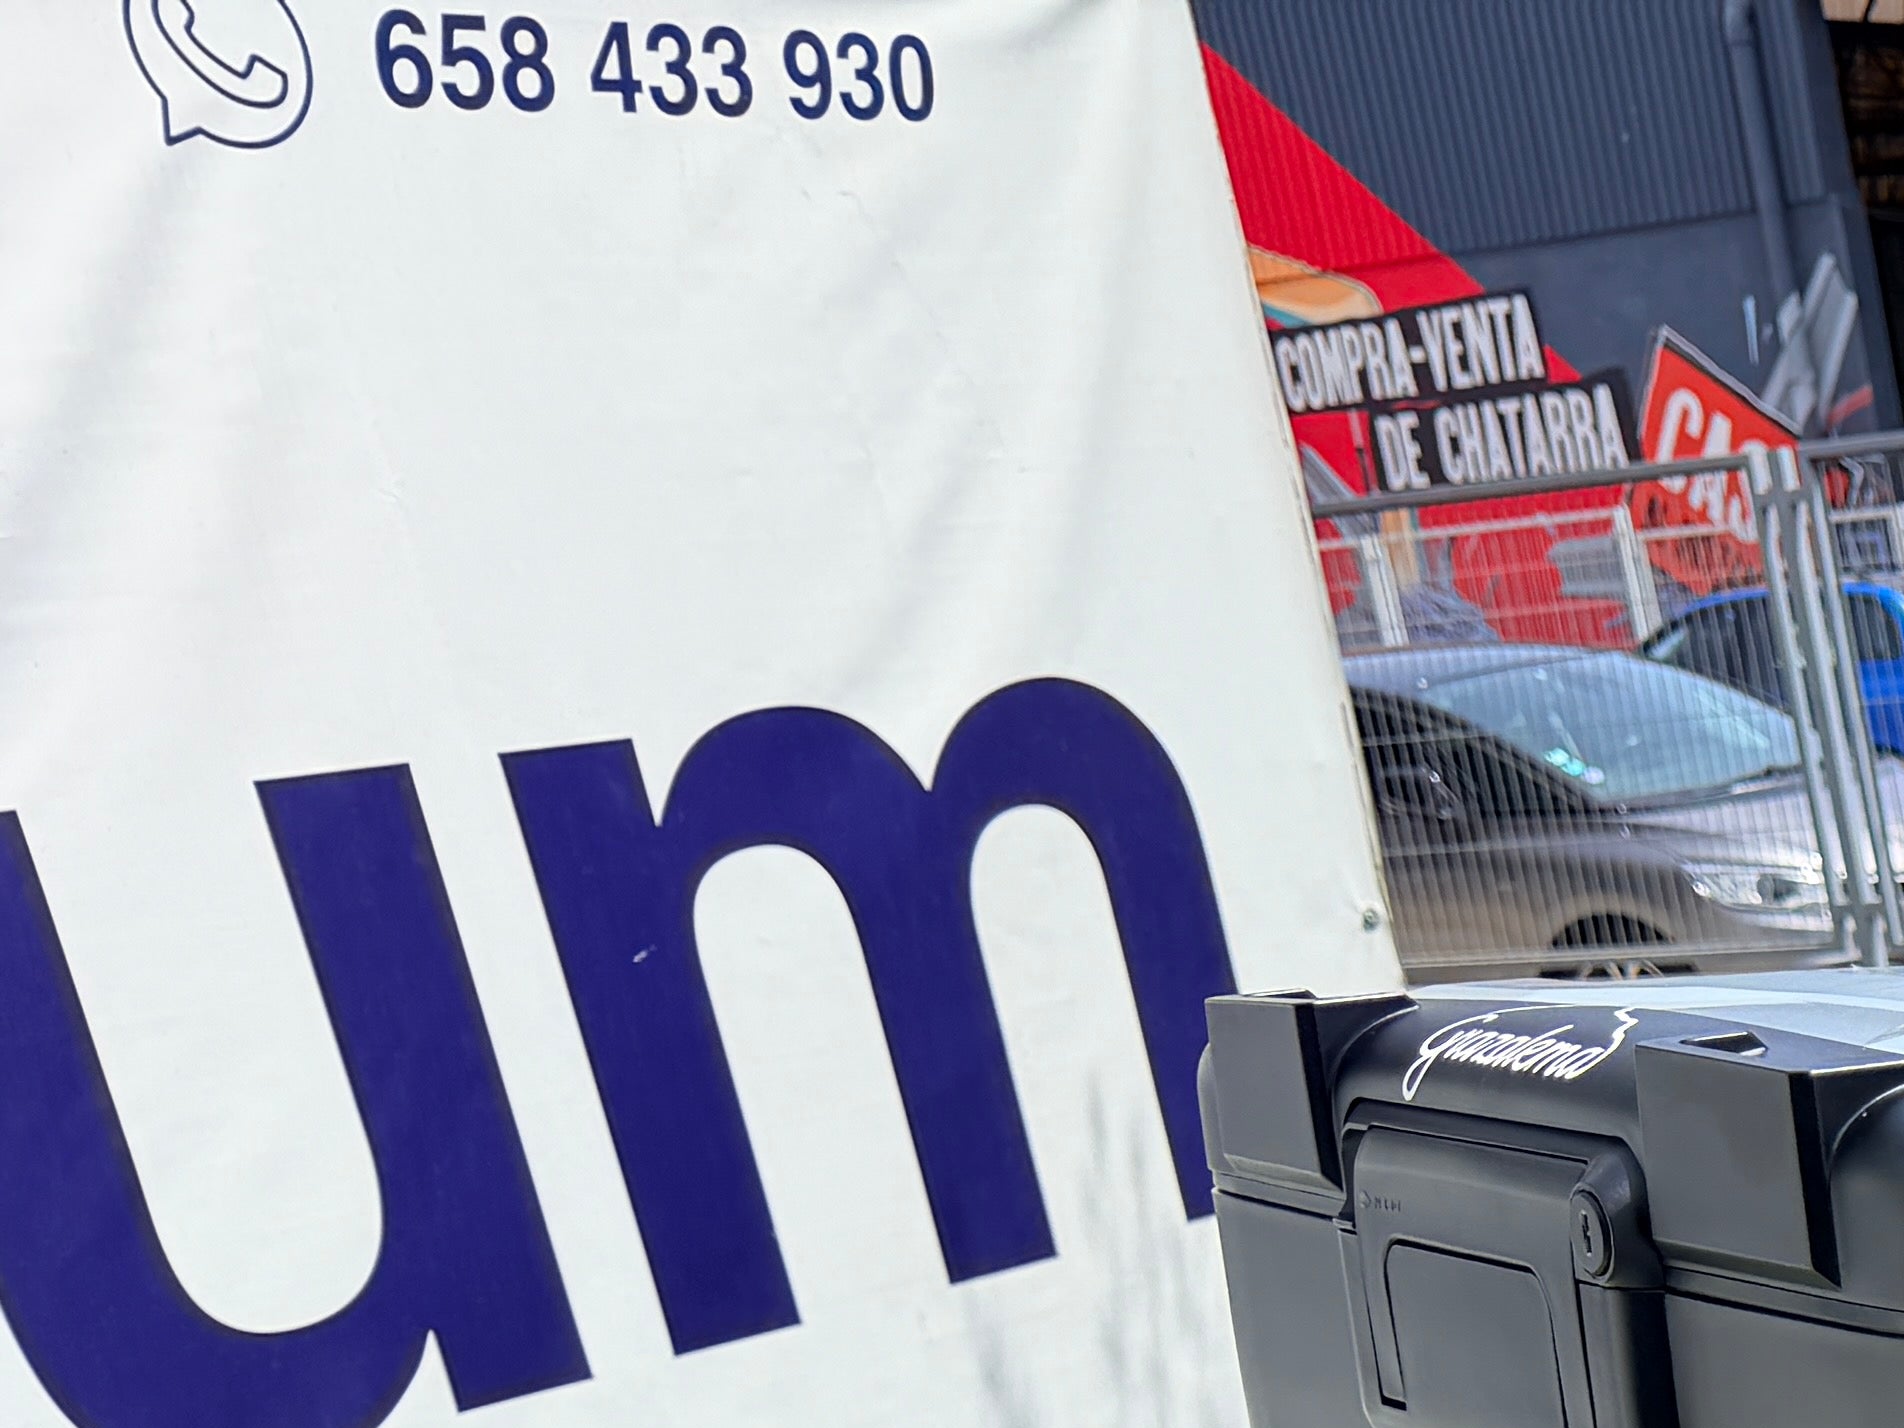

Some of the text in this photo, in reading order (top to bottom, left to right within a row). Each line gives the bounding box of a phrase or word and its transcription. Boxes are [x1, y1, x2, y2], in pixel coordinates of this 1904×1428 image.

[374, 11, 936, 122] 658 433 930
[1274, 294, 1546, 413] COMPRA-VENTA
[1373, 383, 1630, 491] DE CHATARRA
